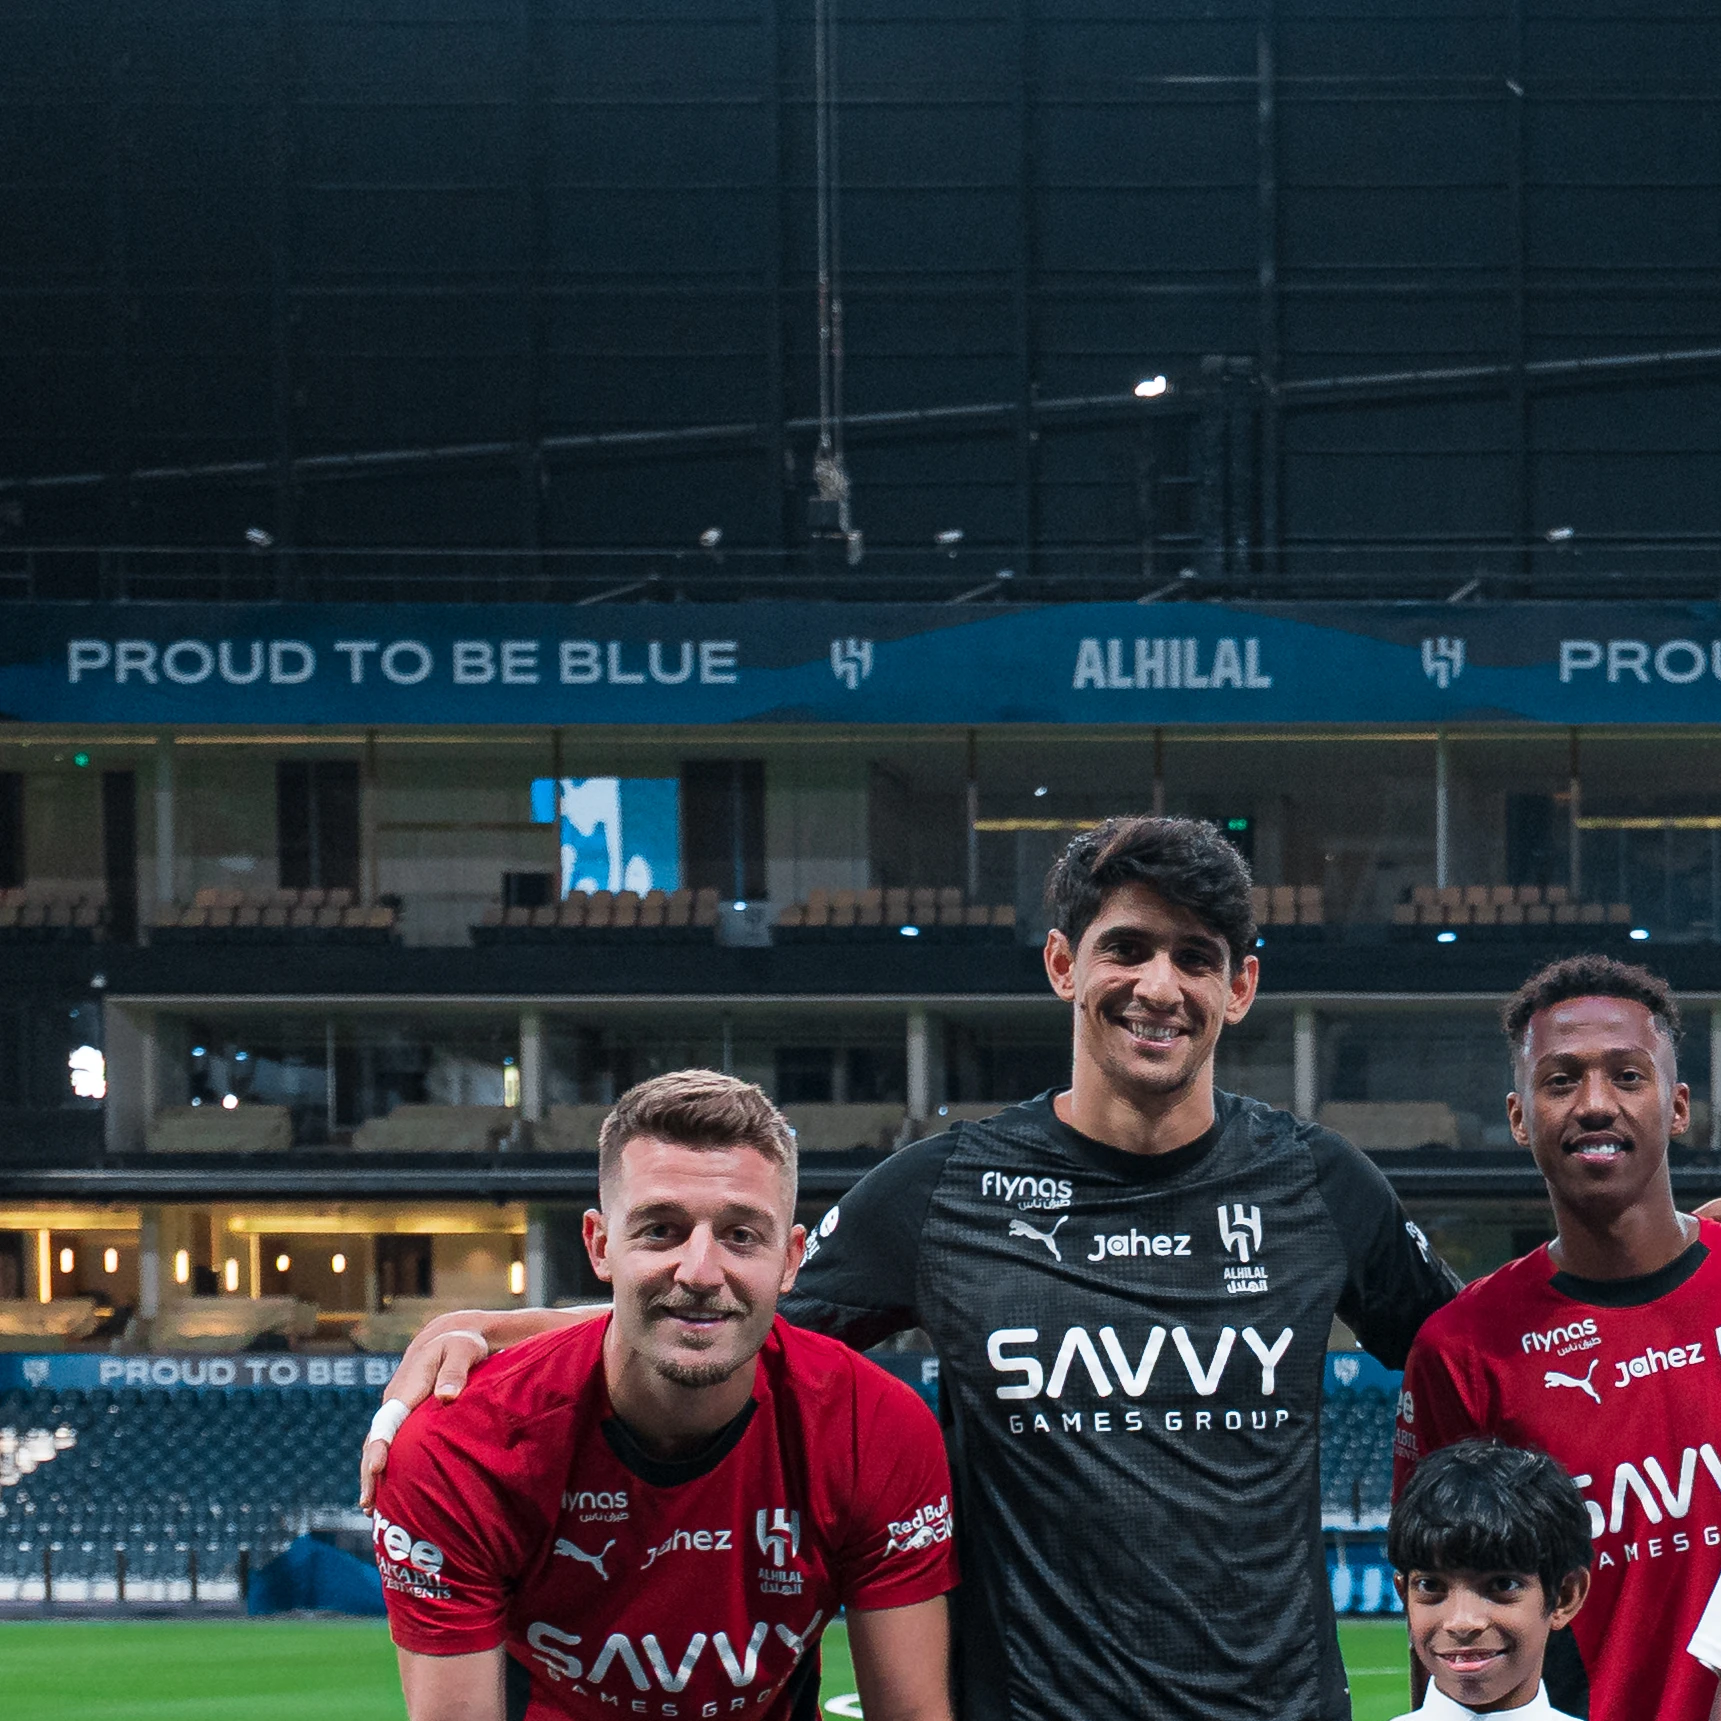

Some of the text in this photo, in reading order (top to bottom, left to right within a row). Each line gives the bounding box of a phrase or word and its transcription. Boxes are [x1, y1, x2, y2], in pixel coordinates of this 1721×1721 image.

[67, 640, 739, 686] PROUD TO BE BLUE
[1072, 637, 1272, 690] ALHILAL
[981, 1171, 1073, 1202] flynas
[1223, 1266, 1269, 1280] ALHILAL
[1521, 1318, 1598, 1354] flynas
[100, 1358, 237, 1387] PROUD
[245, 1358, 298, 1387] TO
[307, 1358, 357, 1387] BE
[986, 1326, 1294, 1400] SAVVY
[1008, 1409, 1290, 1434] GAMES GROUP
[887, 1509, 925, 1538] Red
[923, 1495, 950, 1523] Bull
[372, 1508, 444, 1574] ree
[1599, 1532, 1690, 1570] AMES
[757, 1568, 804, 1583] ALHILAL
[526, 1608, 824, 1693] SAVVY
